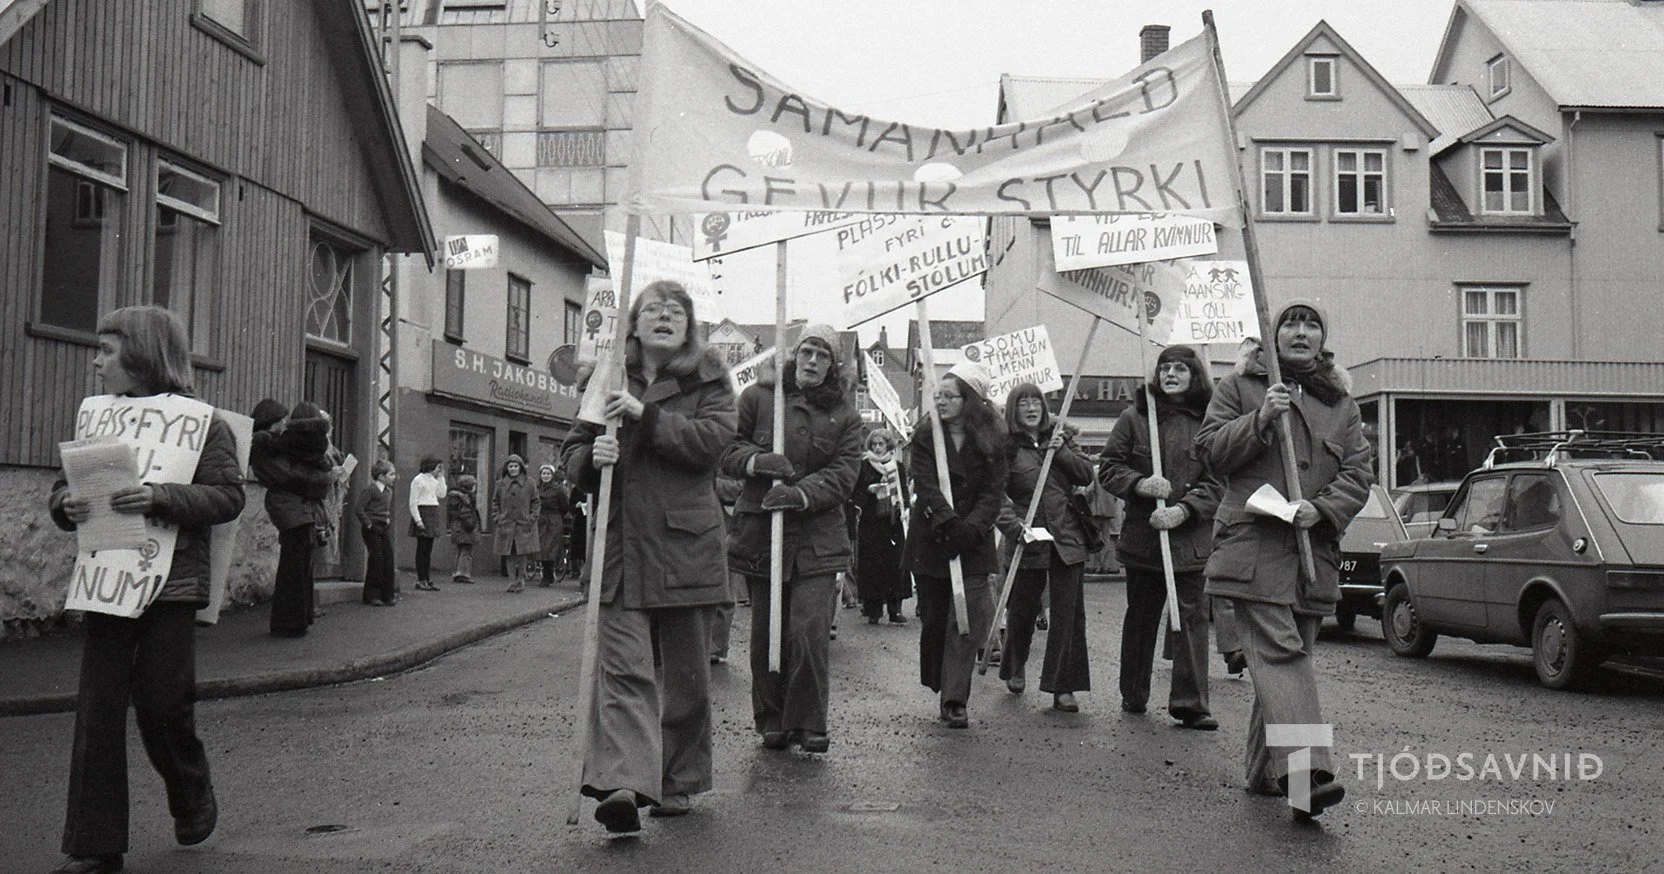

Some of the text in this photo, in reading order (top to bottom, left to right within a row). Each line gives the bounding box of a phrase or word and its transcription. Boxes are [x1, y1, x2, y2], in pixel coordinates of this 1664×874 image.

[997, 160, 1212, 211] STYRKI
[885, 219, 924, 252] FYRI
[1061, 221, 1212, 257] TIL ALLAR KVINNUR
[446, 245, 493, 268] OSRAM
[906, 254, 984, 299] STÓLUM
[983, 329, 1035, 356] SOMU
[1191, 320, 1244, 340] BØRN!
[493, 360, 577, 398] JAKOBSEN
[999, 356, 1035, 376] MENN
